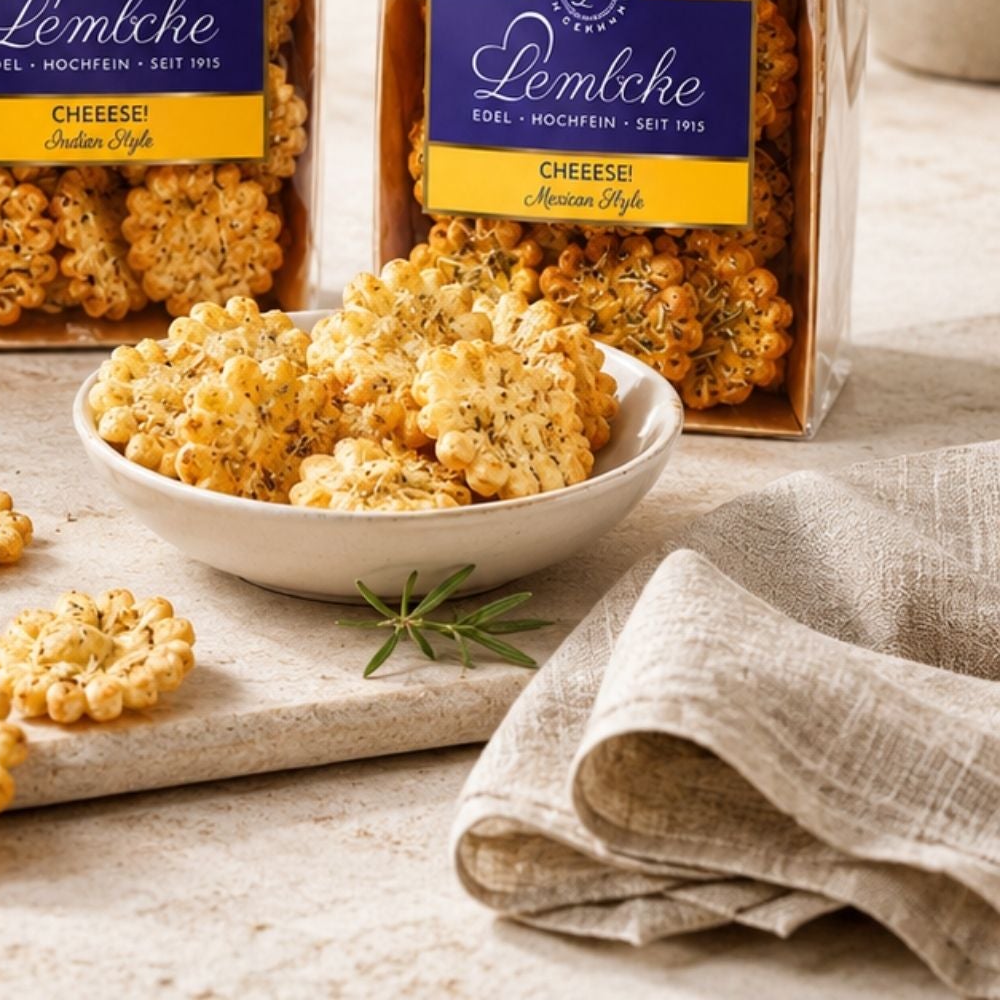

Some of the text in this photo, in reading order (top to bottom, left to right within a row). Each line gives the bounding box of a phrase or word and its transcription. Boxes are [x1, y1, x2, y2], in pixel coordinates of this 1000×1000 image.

[43, 58, 130, 71] HOCHFEIN
[150, 57, 183, 70] SEIT
[191, 57, 220, 69] 1915
[51, 104, 149, 124] CHEEESE!
[472, 108, 705, 133] EDEL HOCHFEIN SEIT 1915
[44, 128, 154, 156] Indian Style
[538, 160, 633, 183] CHEEESE!
[523, 185, 645, 217] Mexican Style
